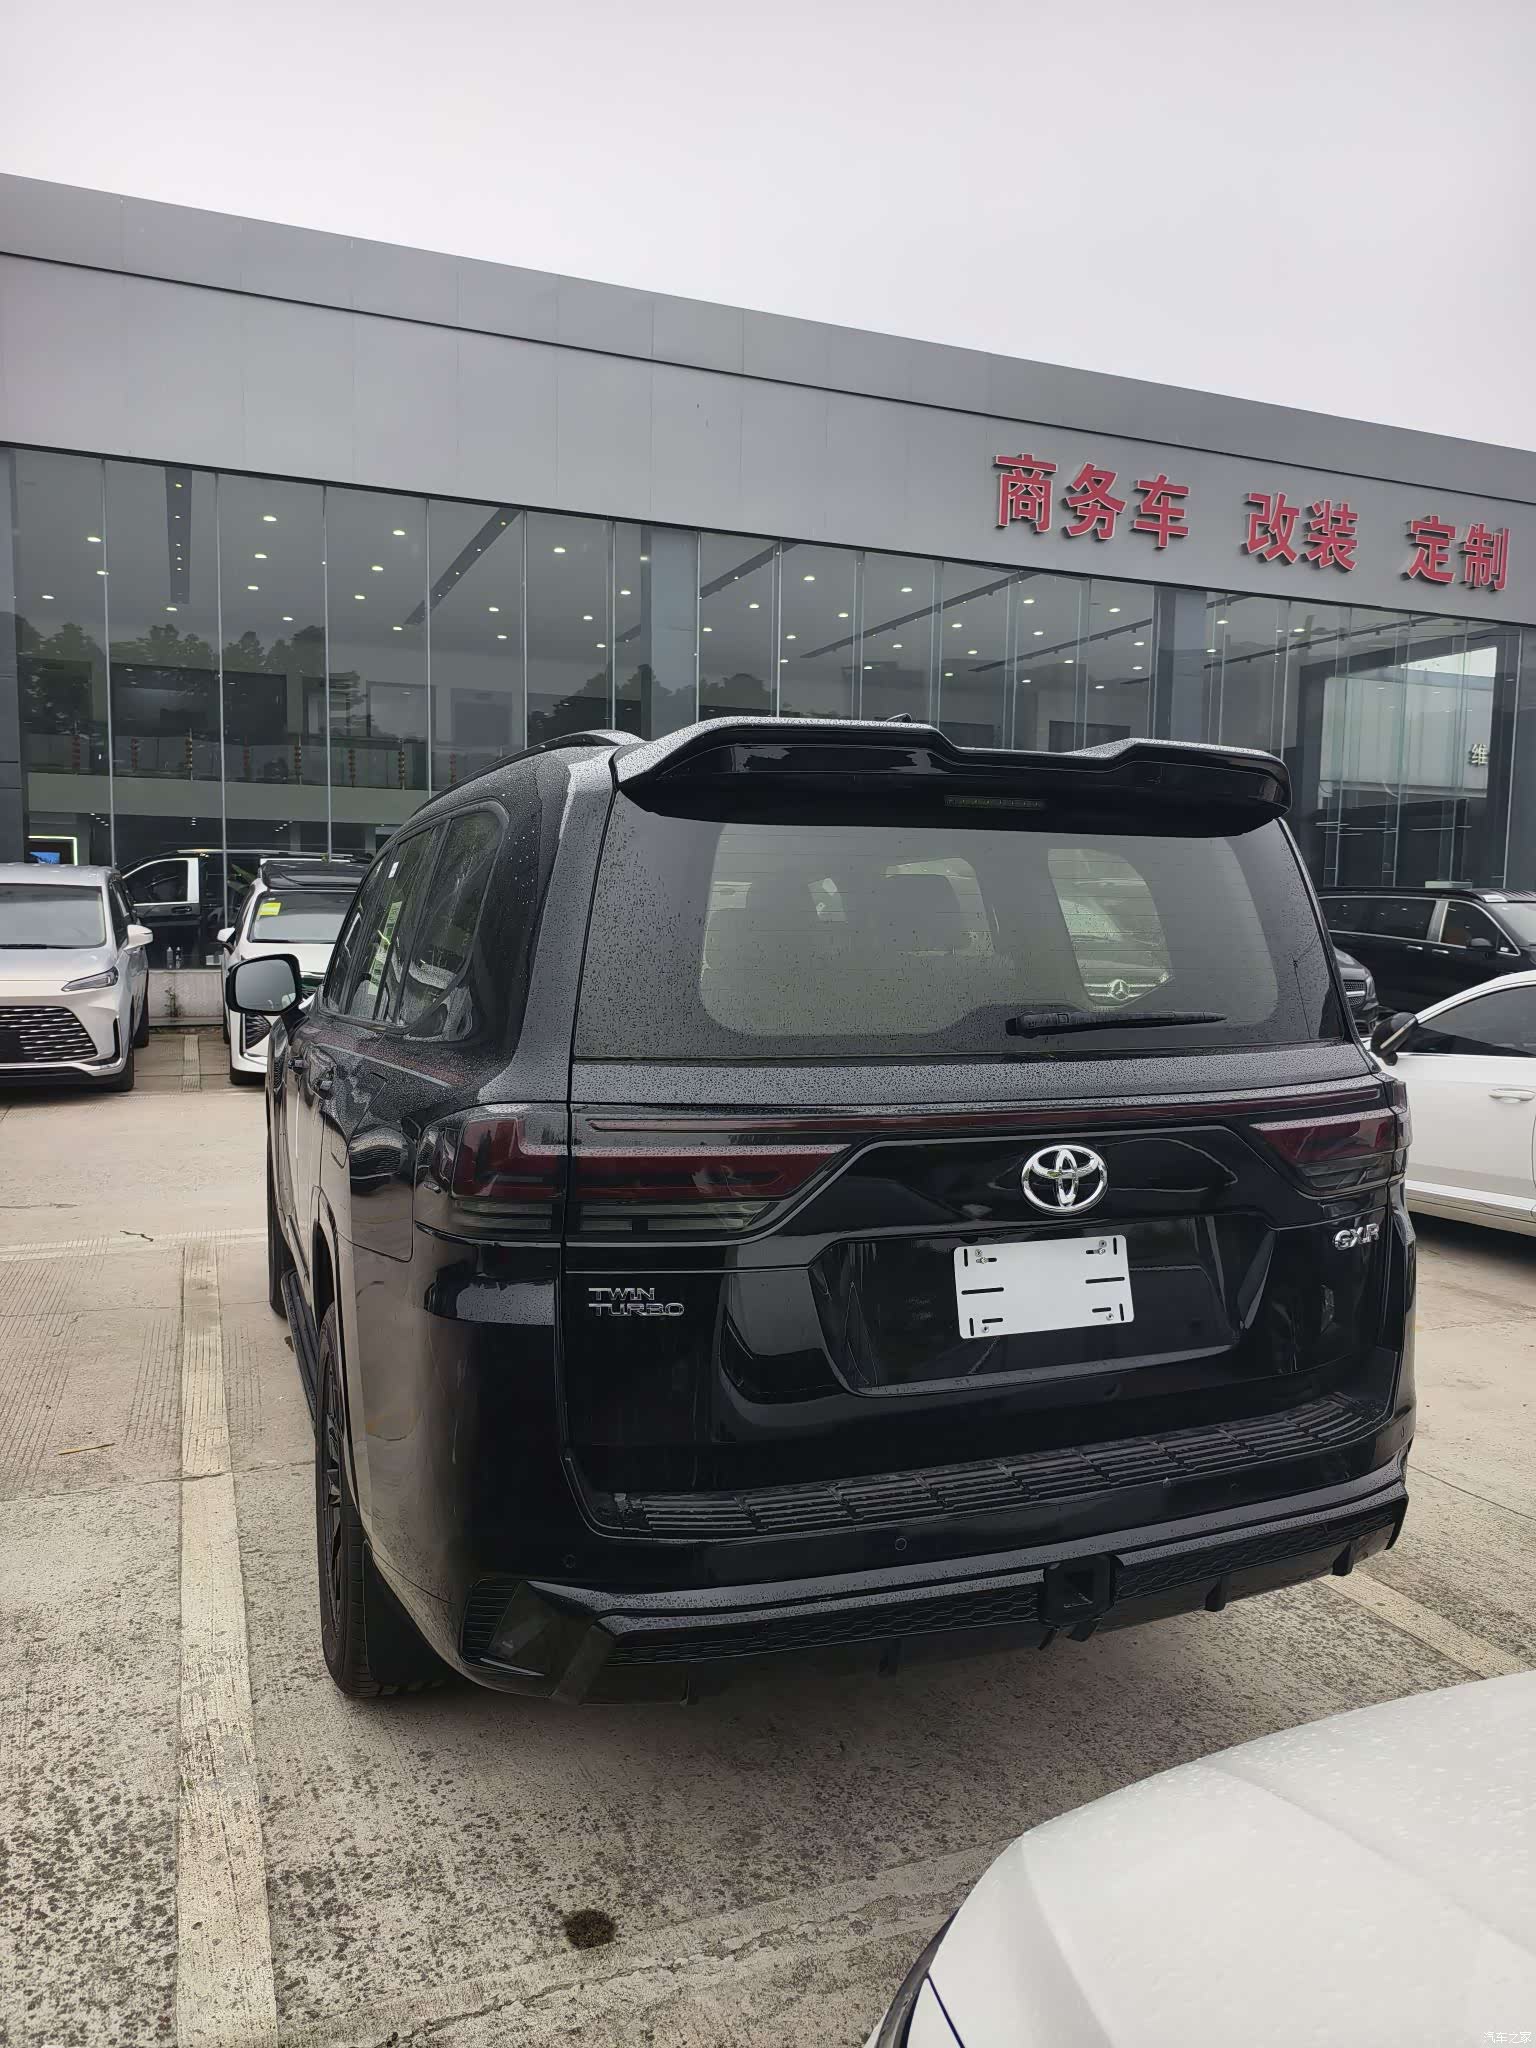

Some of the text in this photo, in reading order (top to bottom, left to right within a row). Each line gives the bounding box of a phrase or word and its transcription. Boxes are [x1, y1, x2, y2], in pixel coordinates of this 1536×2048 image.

[995, 454, 1511, 591] 商务车 改装 定制
[1333, 1223, 1380, 1251] GXR
[588, 1287, 655, 1301] TWIN
[588, 1302, 685, 1317] TURBO
